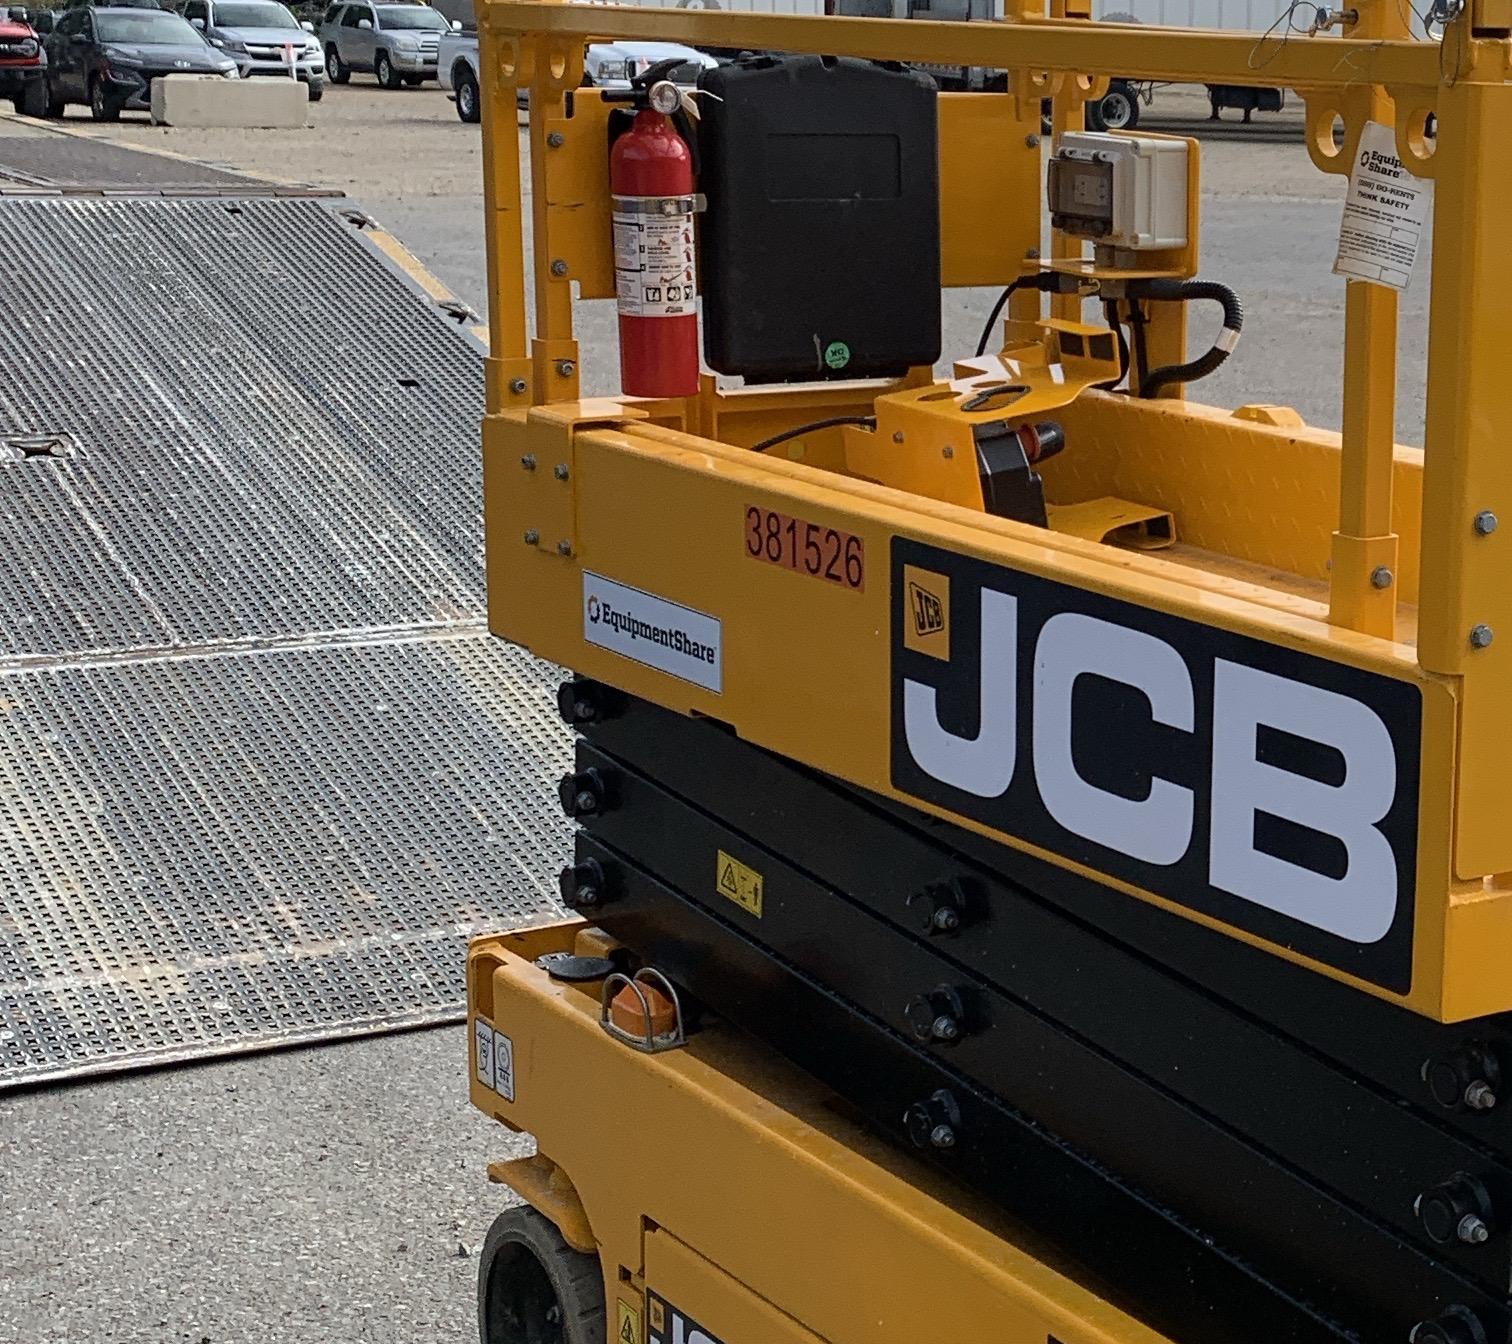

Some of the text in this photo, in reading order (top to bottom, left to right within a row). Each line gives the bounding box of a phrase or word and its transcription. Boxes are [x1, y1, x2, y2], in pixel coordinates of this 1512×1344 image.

[1367, 162, 1401, 179] Share
[1379, 197, 1411, 211] SAFETY
[746, 506, 863, 589] 381526
[602, 602, 716, 666] EquipmentShare
[916, 589, 943, 633] JCB
[904, 586, 1398, 944] JCB
